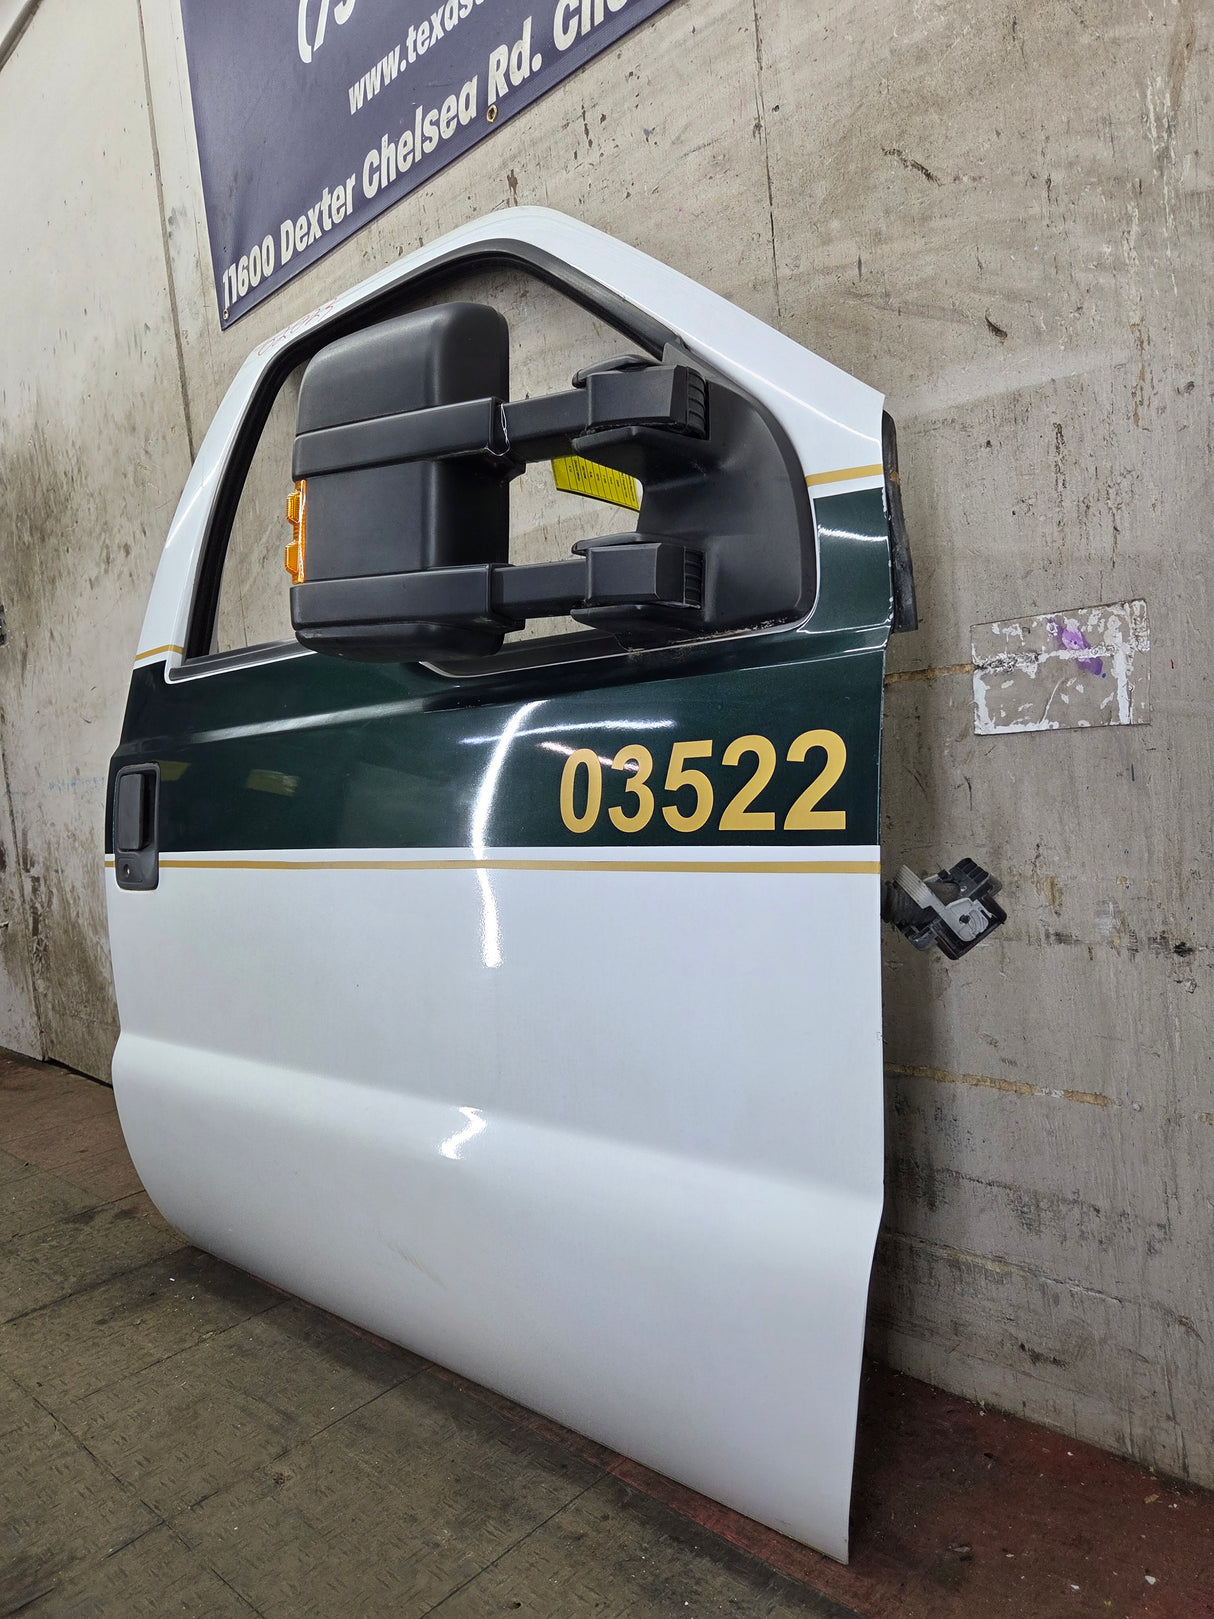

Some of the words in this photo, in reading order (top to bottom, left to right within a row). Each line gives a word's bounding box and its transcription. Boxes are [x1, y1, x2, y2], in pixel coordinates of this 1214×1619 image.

[222, 234, 275, 309] 11600
[280, 173, 356, 266] Dexter
[362, 75, 478, 199] Chelsea
[488, 16, 542, 106] Rd.
[560, 729, 847, 833] 03522
